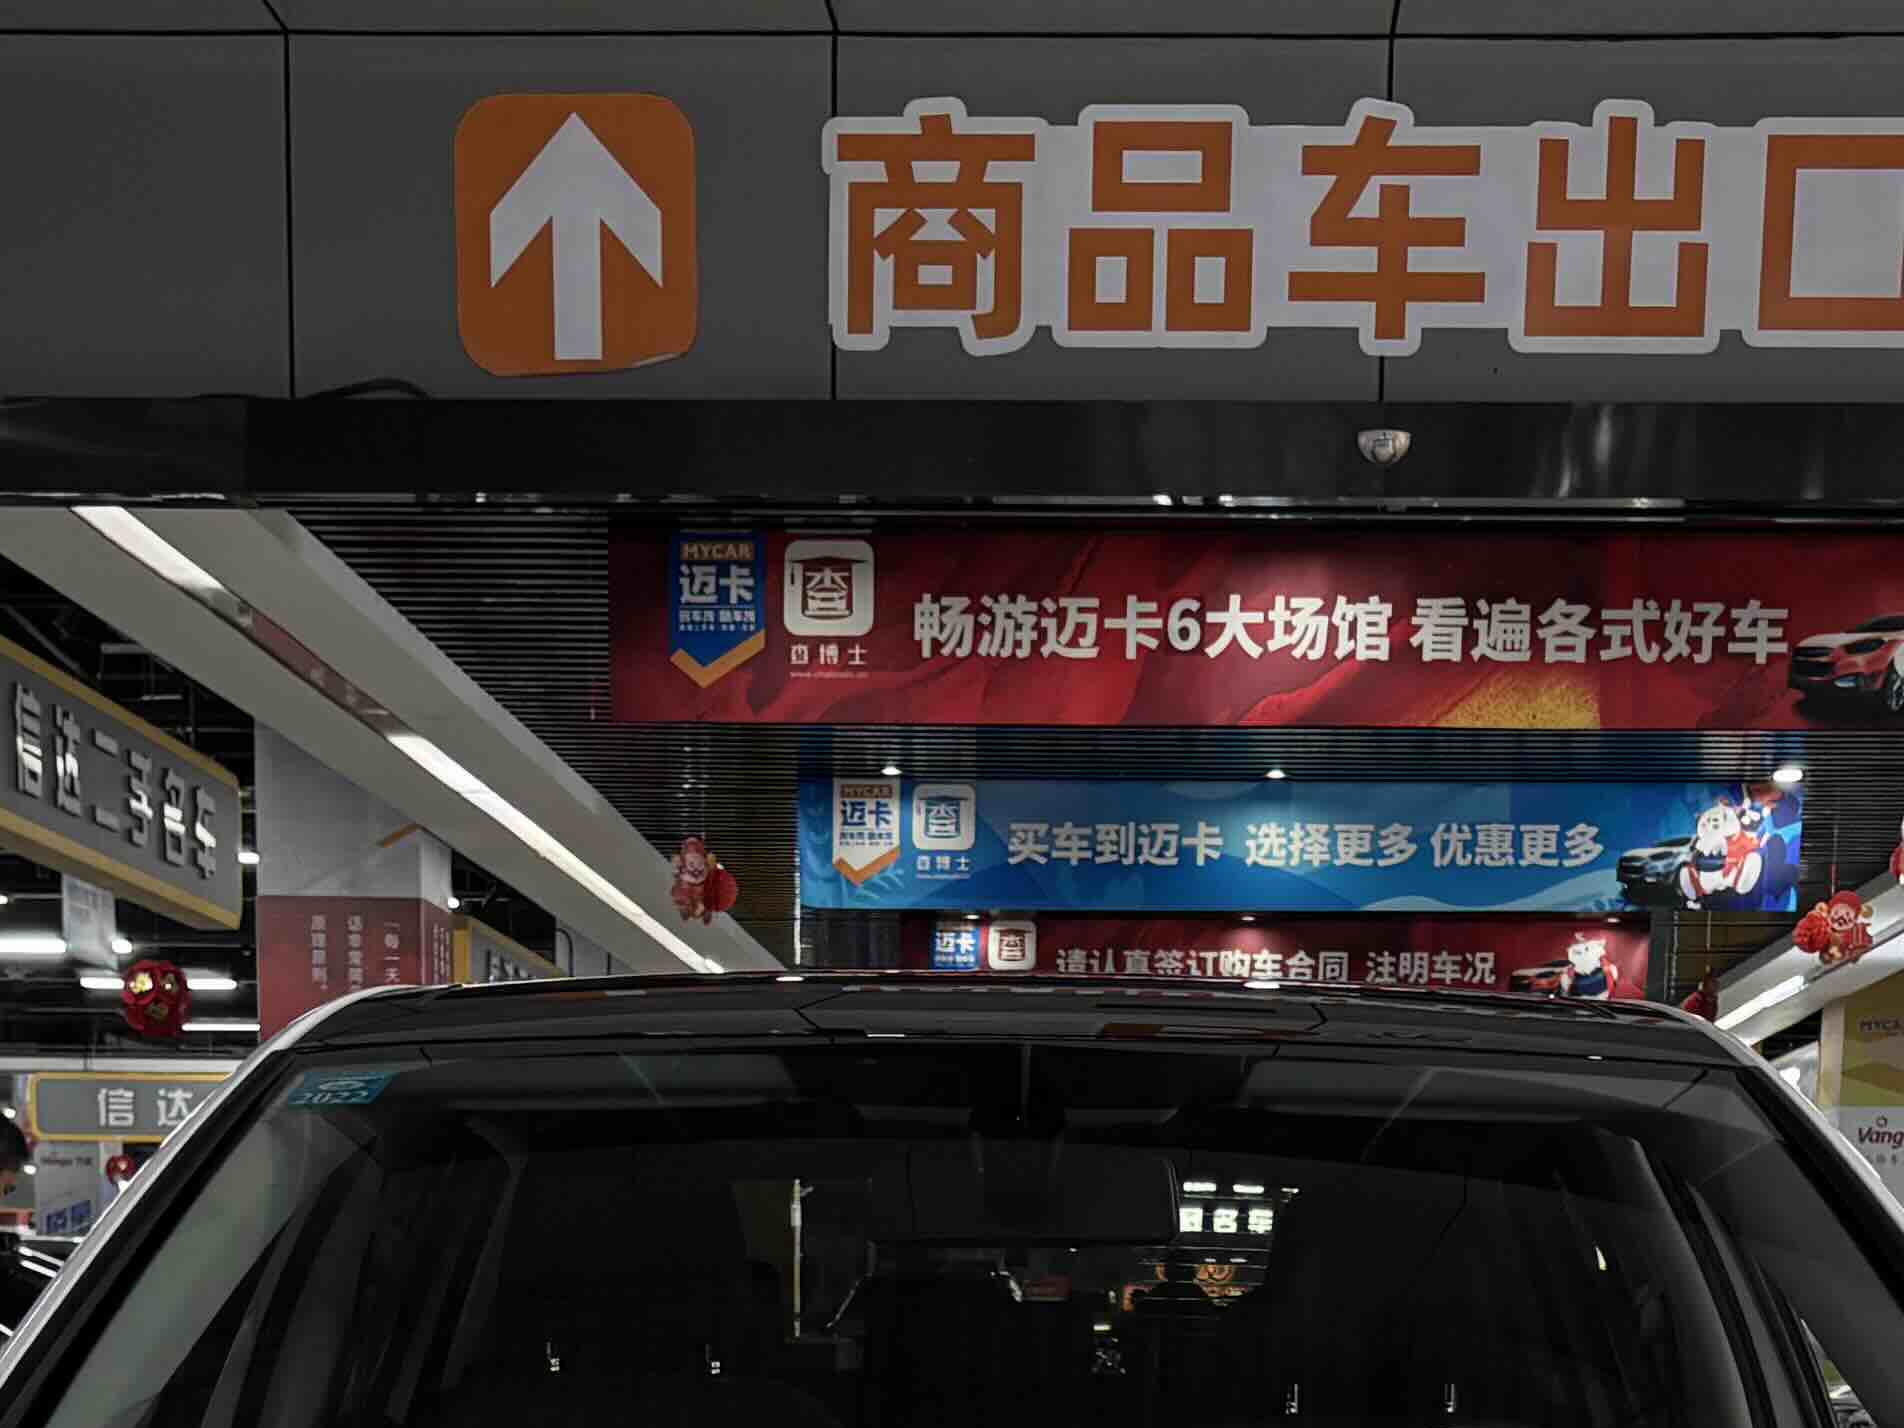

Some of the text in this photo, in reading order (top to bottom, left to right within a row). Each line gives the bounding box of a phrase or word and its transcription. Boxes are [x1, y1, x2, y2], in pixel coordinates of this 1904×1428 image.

[679, 565, 756, 604] 迈卡
[913, 592, 1790, 664] 畅游迈卡6大场馆 看遍各式好车
[790, 644, 868, 665] 查博士
[14, 681, 217, 880] 信达二手名车
[840, 800, 894, 829] 迈卡
[1007, 821, 1605, 868] 买车到迈卡 选择更多 优惠更多
[1056, 948, 1496, 984] 请认真签订购车合同 注明车况
[98, 1085, 194, 1128] 信达
